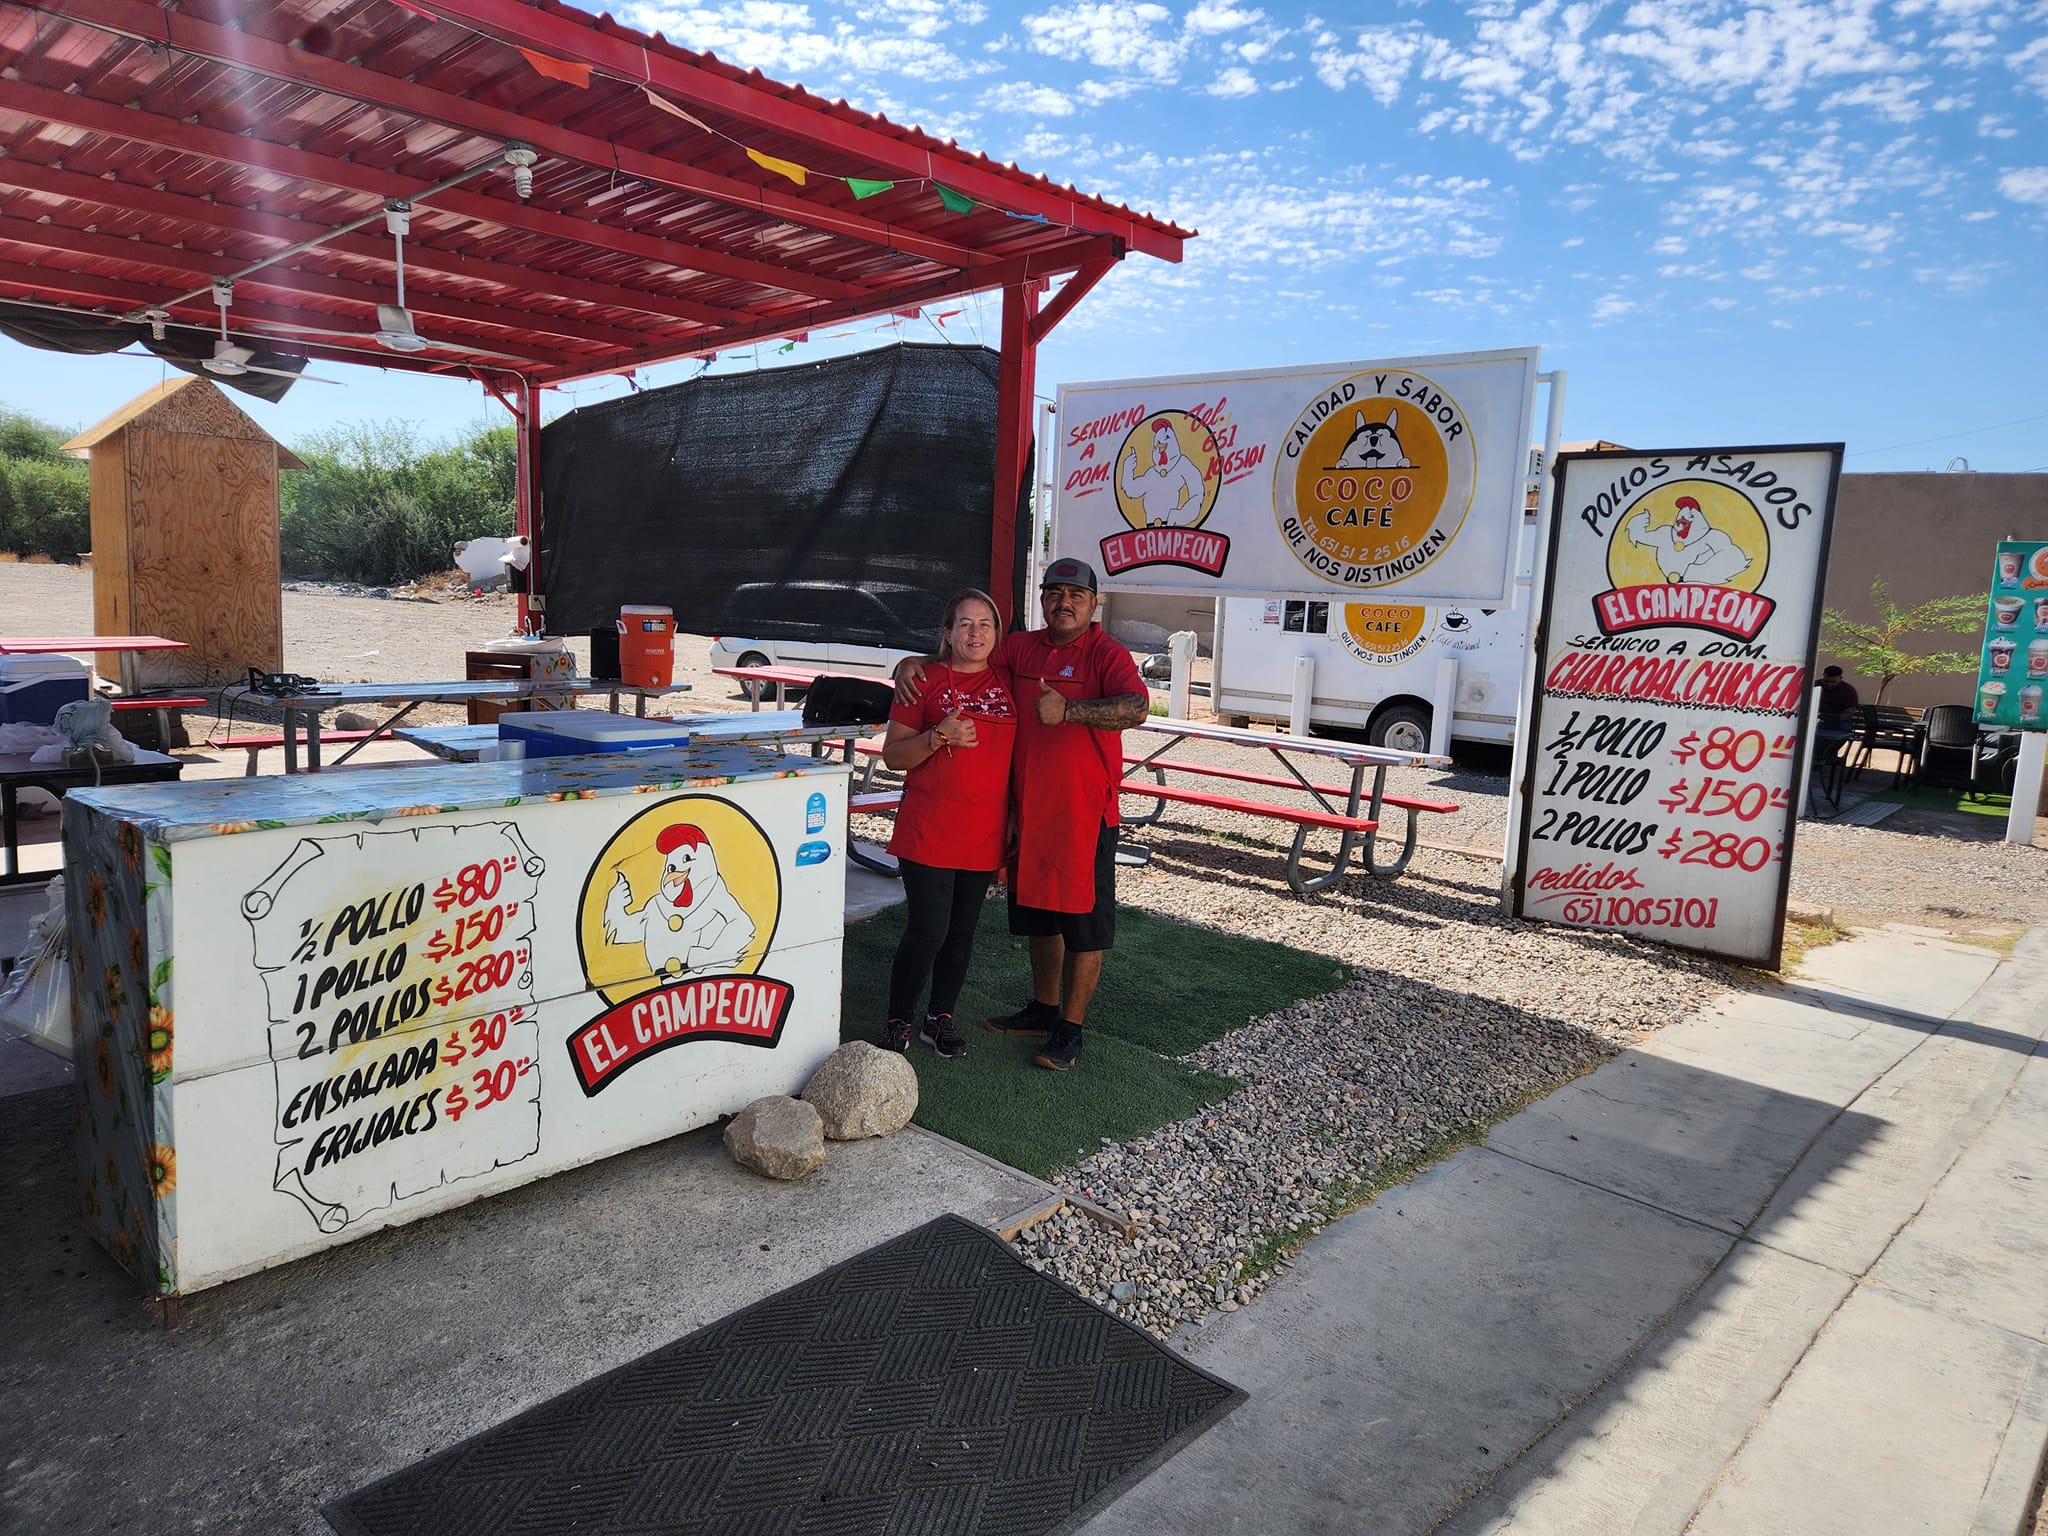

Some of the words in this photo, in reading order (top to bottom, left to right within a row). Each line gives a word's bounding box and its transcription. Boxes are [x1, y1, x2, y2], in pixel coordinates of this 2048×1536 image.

[1067, 404, 1145, 447] SERVICIO
[1184, 397, 1227, 432] Tel.
[1286, 383, 1355, 458] CALIDAD
[1375, 375, 1387, 394] Y
[1396, 378, 1463, 441] SABOR
[1080, 443, 1095, 460] A
[1202, 425, 1237, 452] 651
[1065, 462, 1111, 490] DOM.
[1204, 444, 1266, 481] 1065101
[1315, 476, 1413, 502] COCO
[1581, 458, 1670, 537] POLLOS
[1686, 455, 1812, 530] ASADOS
[1326, 501, 1393, 528] CAFÉ
[1106, 539, 1131, 567] EL
[1135, 532, 1221, 565] CAMPEON
[1283, 517, 1306, 547] QUE
[1304, 547, 1341, 576] NOS
[1344, 528, 1446, 582] DISTINGUEN
[1304, 516, 1319, 541] TEL.
[1320, 537, 1339, 552] 651
[1341, 545, 1355, 559] 51
[1359, 548, 1369, 560] 2
[1375, 545, 1391, 560] 25
[1395, 536, 1409, 552] 16
[1360, 607, 1411, 620] COCO
[1366, 621, 1402, 633] CAFE
[1603, 595, 1635, 625] EL
[1636, 587, 1764, 632] CAMPEÓN
[1341, 632, 1354, 647] QUE
[1354, 646, 1373, 661] NOS
[1378, 634, 1426, 663] DISTINGUEN
[1666, 641, 1687, 656] A
[1698, 641, 1767, 660] DOM.
[1546, 652, 1691, 700] CHARCOAL
[1680, 659, 1806, 710] CHICKEN
[1576, 715, 1667, 759] POLLO
[1542, 760, 1568, 796] 1
[1561, 762, 1650, 806] POLLO
[1532, 809, 1558, 841] 2
[1553, 812, 1659, 855] POLLOS
[323, 882, 425, 957] POLLO
[1562, 897, 1719, 928] 6511065101
[293, 973, 308, 1014] 1
[310, 942, 407, 1011] POLLO
[296, 1021, 323, 1060] 2
[329, 978, 433, 1054] POLLOS
[582, 1023, 628, 1073] EL
[632, 981, 776, 1044] CAMPEON
[282, 1037, 438, 1129] ENSALADA
[304, 1088, 443, 1176] FRIJOLES
